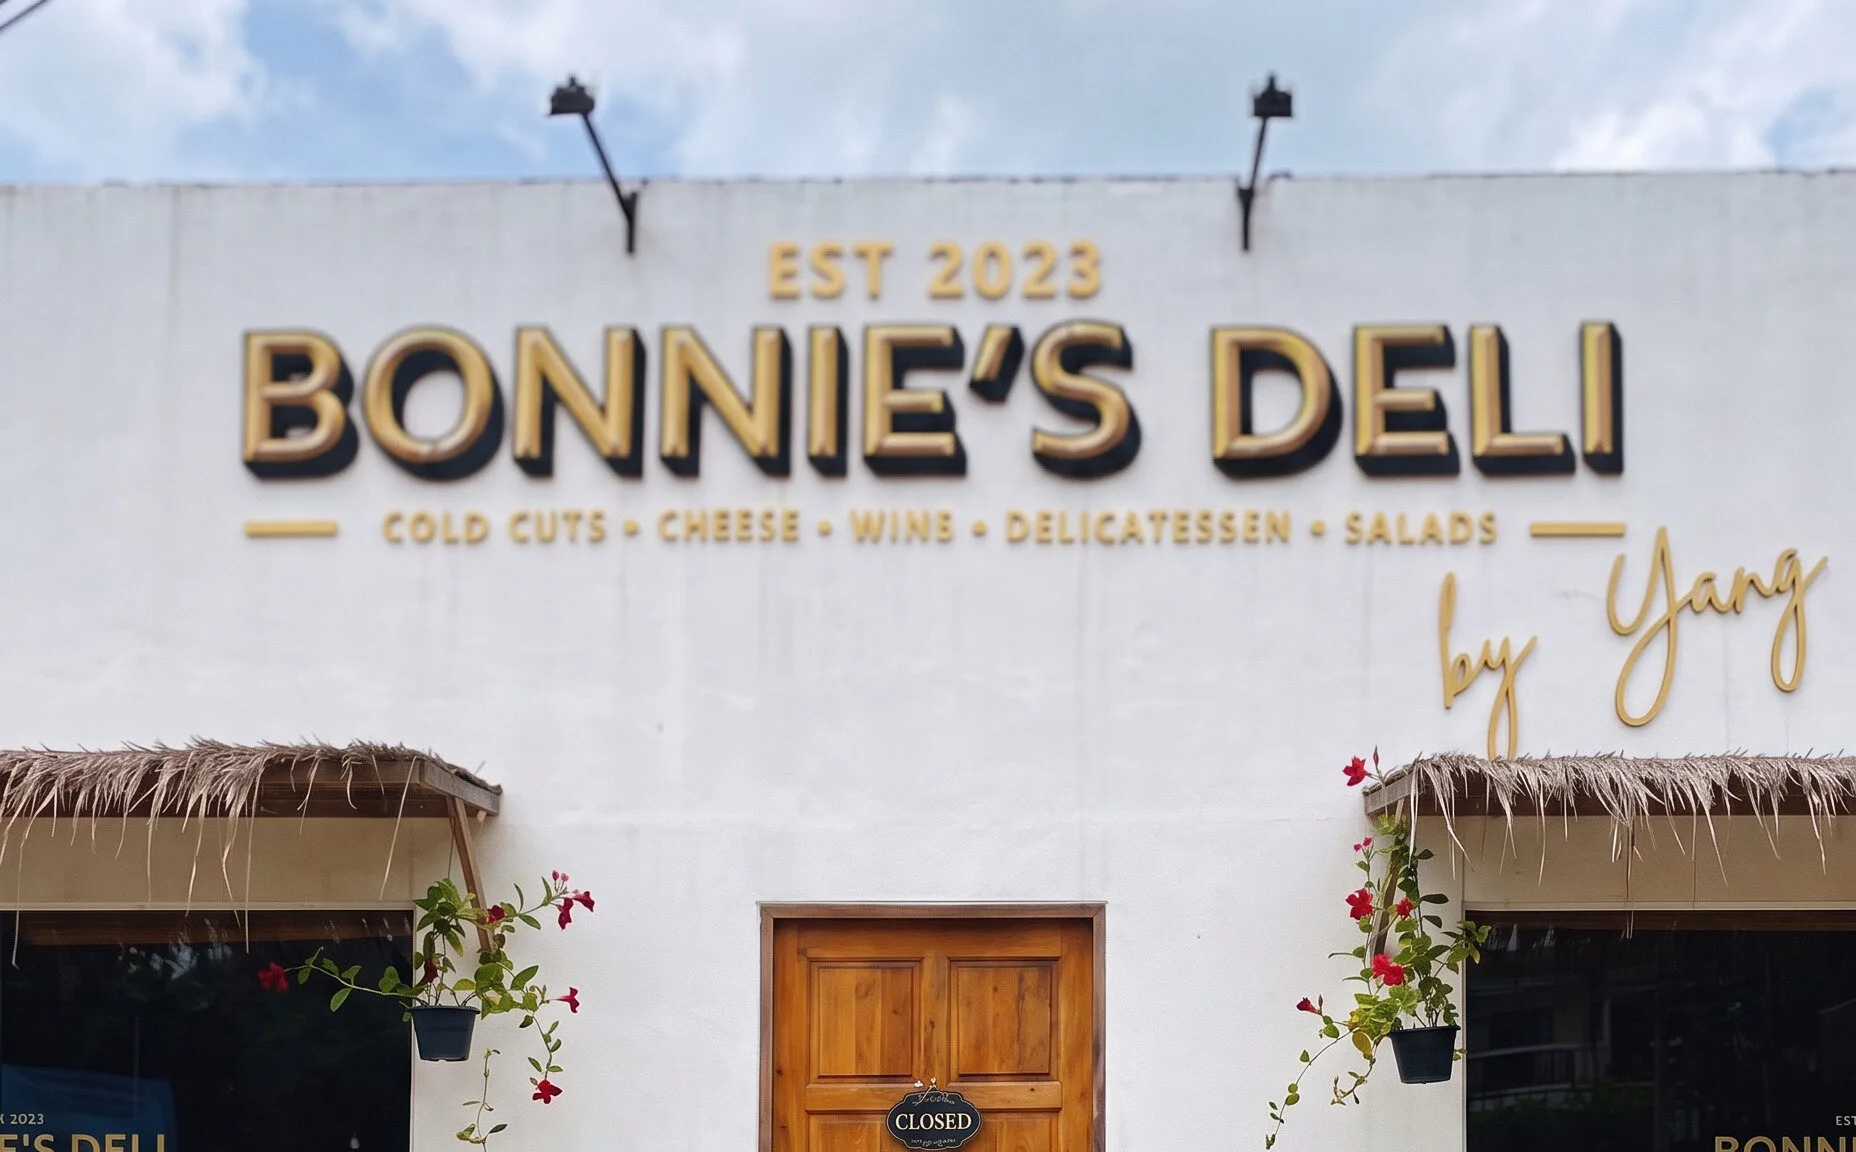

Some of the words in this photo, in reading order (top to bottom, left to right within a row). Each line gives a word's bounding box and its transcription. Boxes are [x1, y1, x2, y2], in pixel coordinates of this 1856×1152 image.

[769, 241, 894, 300] EST
[928, 240, 1102, 300] 2023
[243, 324, 1142, 480] BONNIE'S
[1210, 321, 1624, 477] DELI
[382, 510, 490, 545] COLD
[508, 510, 608, 545] CUTS
[656, 509, 800, 543] CHEESE
[850, 509, 956, 543] WINE
[1005, 510, 1293, 545] DELICATESSEN
[1344, 510, 1498, 545] SALADS
[1438, 570, 1538, 761] by
[1605, 525, 1829, 728] Yang
[10, 1113, 44, 1125] 2023
[895, 1113, 972, 1130] CLOSED
[1835, 1115, 1856, 1126] EST
